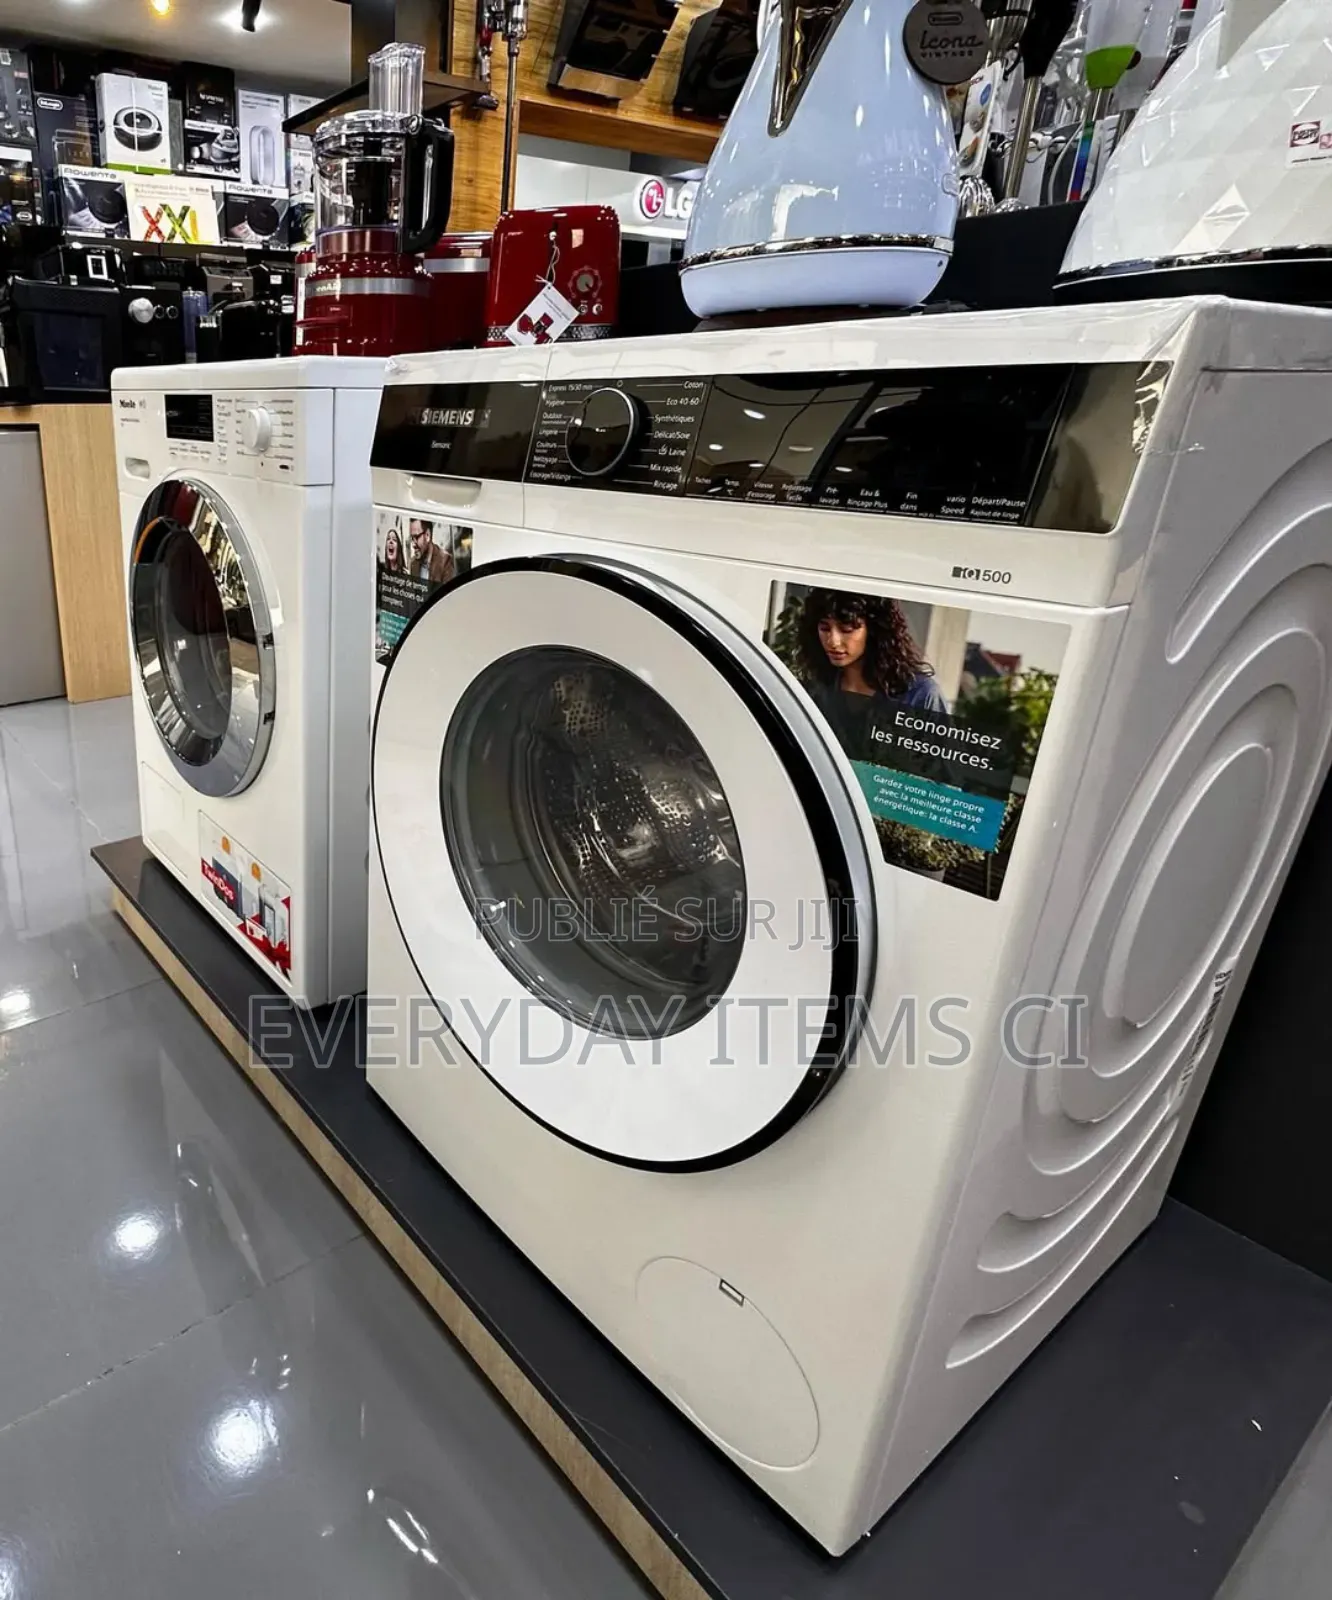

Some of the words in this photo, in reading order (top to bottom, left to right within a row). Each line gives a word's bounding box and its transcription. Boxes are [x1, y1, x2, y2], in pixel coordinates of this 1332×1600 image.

[664, 187, 695, 220] LG
[683, 380, 704, 389] Coton
[666, 397, 678, 406] Eco
[421, 408, 475, 426] SIEMENS
[668, 448, 687, 456] Laine
[650, 463, 661, 471] Mix
[661, 465, 682, 473] rapide
[860, 488, 873, 497] Eau
[906, 492, 918, 500] Fin
[847, 499, 873, 508] Rinçage
[874, 500, 888, 509] Plus
[900, 503, 918, 511] dans
[971, 497, 1026, 507] Départ/Pause
[941, 505, 965, 515] Speed
[1003, 511, 1020, 520] linge
[894, 711, 1002, 750] Economisez
[871, 726, 893, 744] les
[897, 735, 994, 771] ressources.
[873, 774, 902, 790] Gardez
[904, 784, 927, 797] votre
[928, 790, 950, 805] linge
[953, 798, 985, 814] propre
[879, 787, 899, 799] avec
[900, 792, 908, 800] la
[910, 794, 952, 814] meilleure
[954, 809, 982, 823] classe
[928, 812, 938, 821] la
[939, 816, 967, 830] classe
